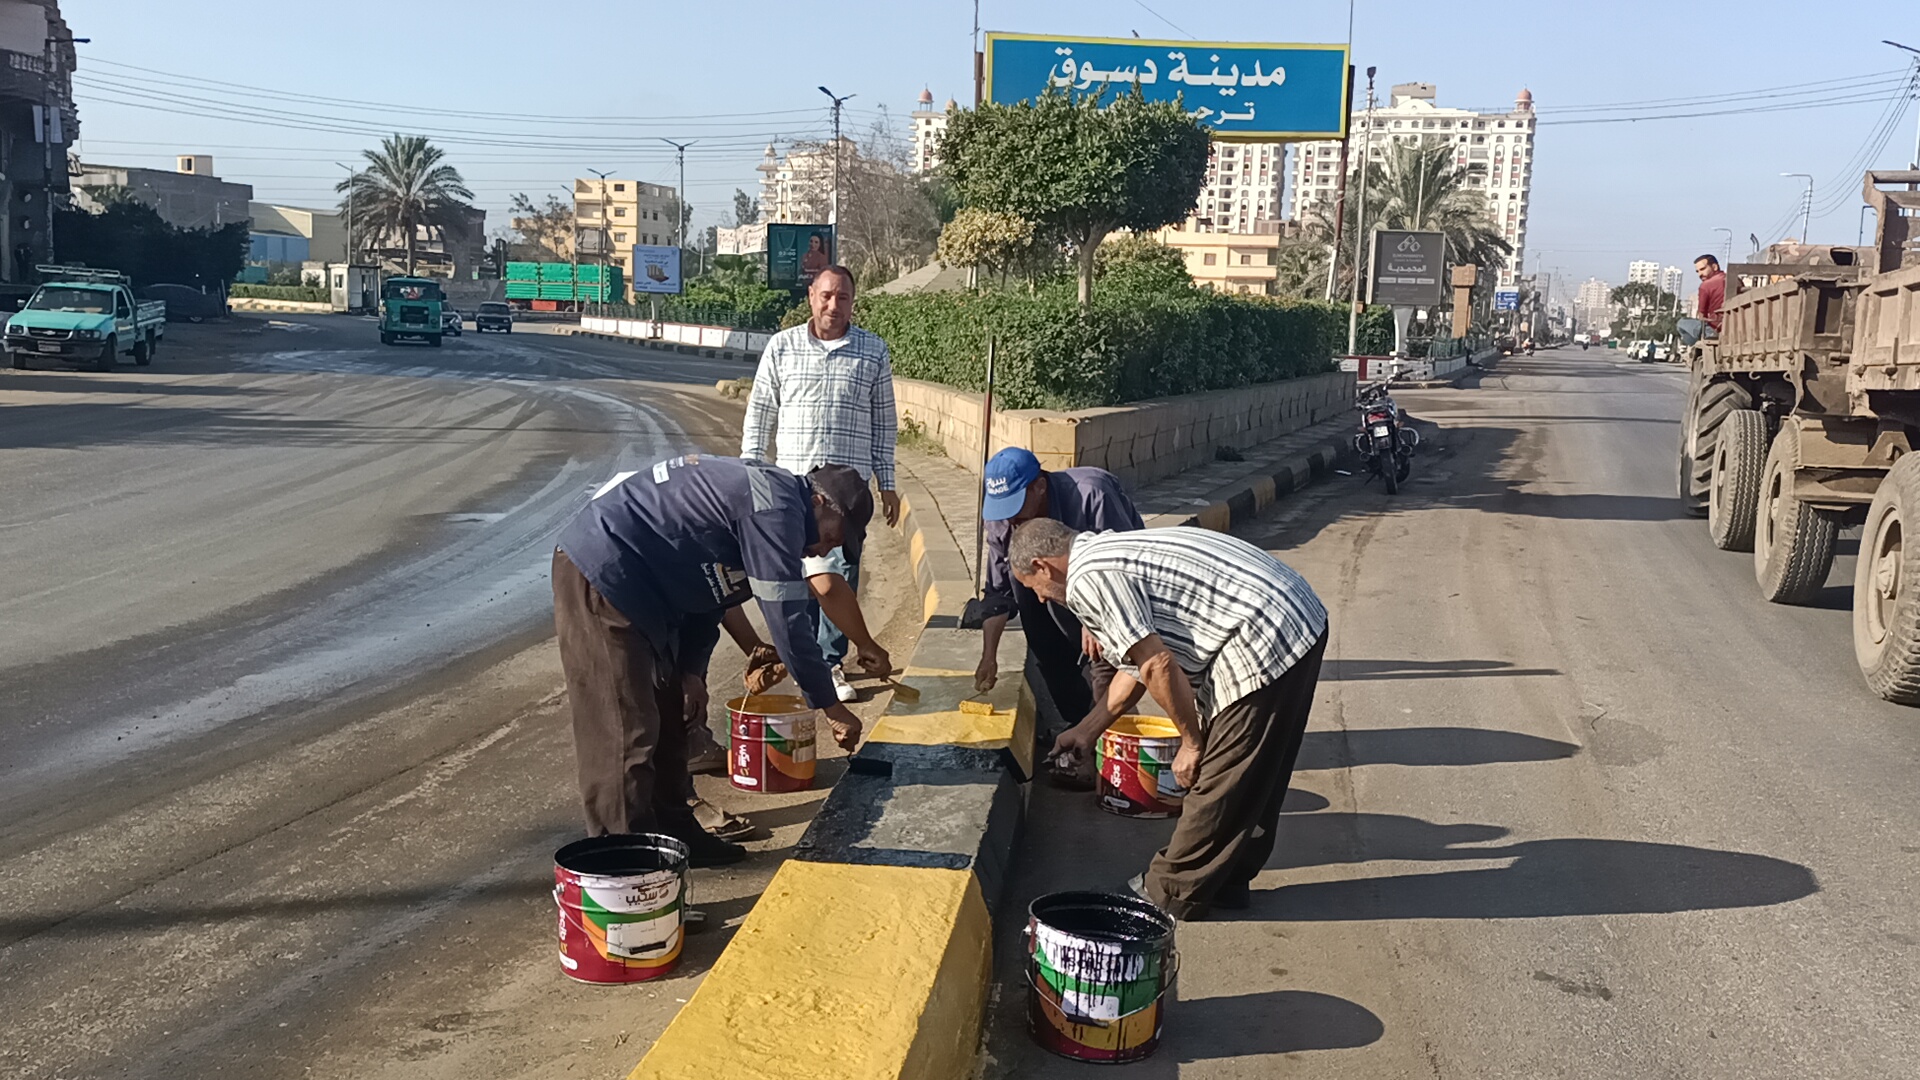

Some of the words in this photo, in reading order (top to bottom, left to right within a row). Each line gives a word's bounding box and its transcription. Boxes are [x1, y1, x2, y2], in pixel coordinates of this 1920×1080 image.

[1048, 46, 1158, 90] دسوق
[1166, 50, 1287, 98] مدينة
[1185, 101, 1256, 125] ترح
